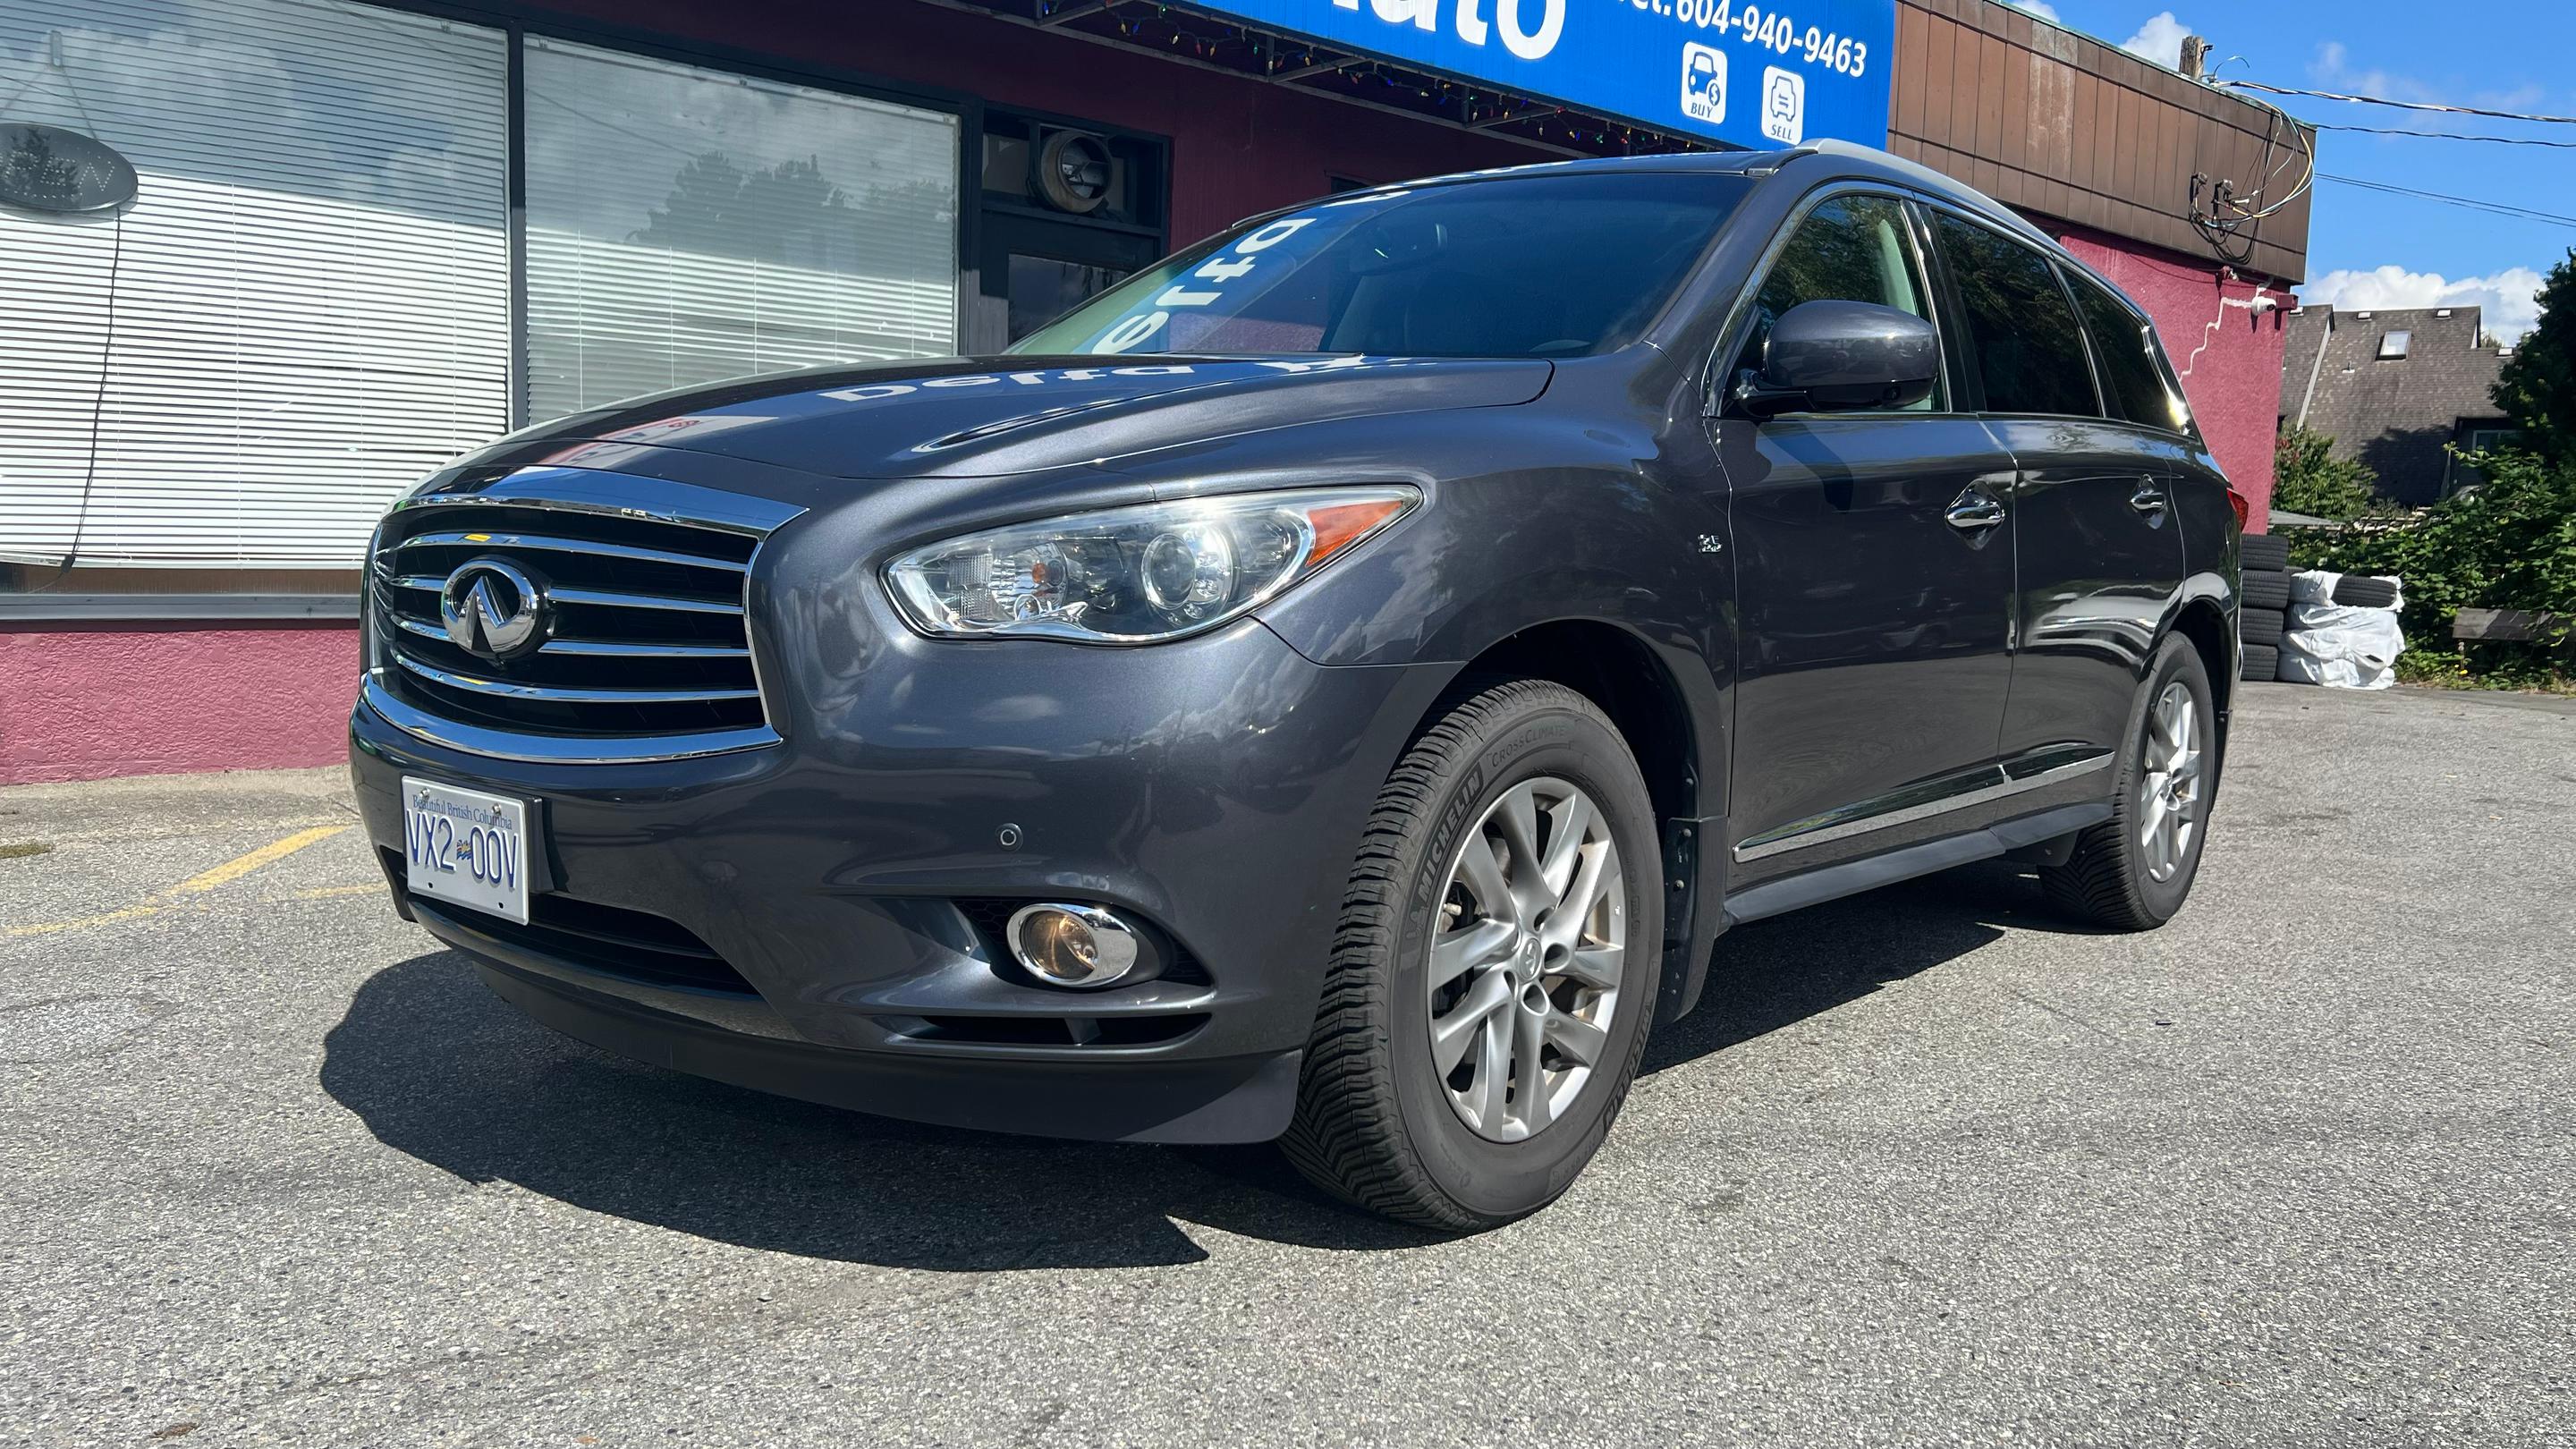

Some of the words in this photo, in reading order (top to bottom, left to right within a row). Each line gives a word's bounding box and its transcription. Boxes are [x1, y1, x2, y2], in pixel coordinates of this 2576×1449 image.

[1690, 102, 1714, 119] BUY
[1771, 124, 1793, 141] SELL
[0, 150, 115, 191] PEN
[413, 795, 446, 814] Beautiful
[447, 802, 473, 821] British
[473, 808, 513, 830] Columbia
[407, 809, 457, 872] VX2
[1418, 769, 1483, 902] MICHELIN
